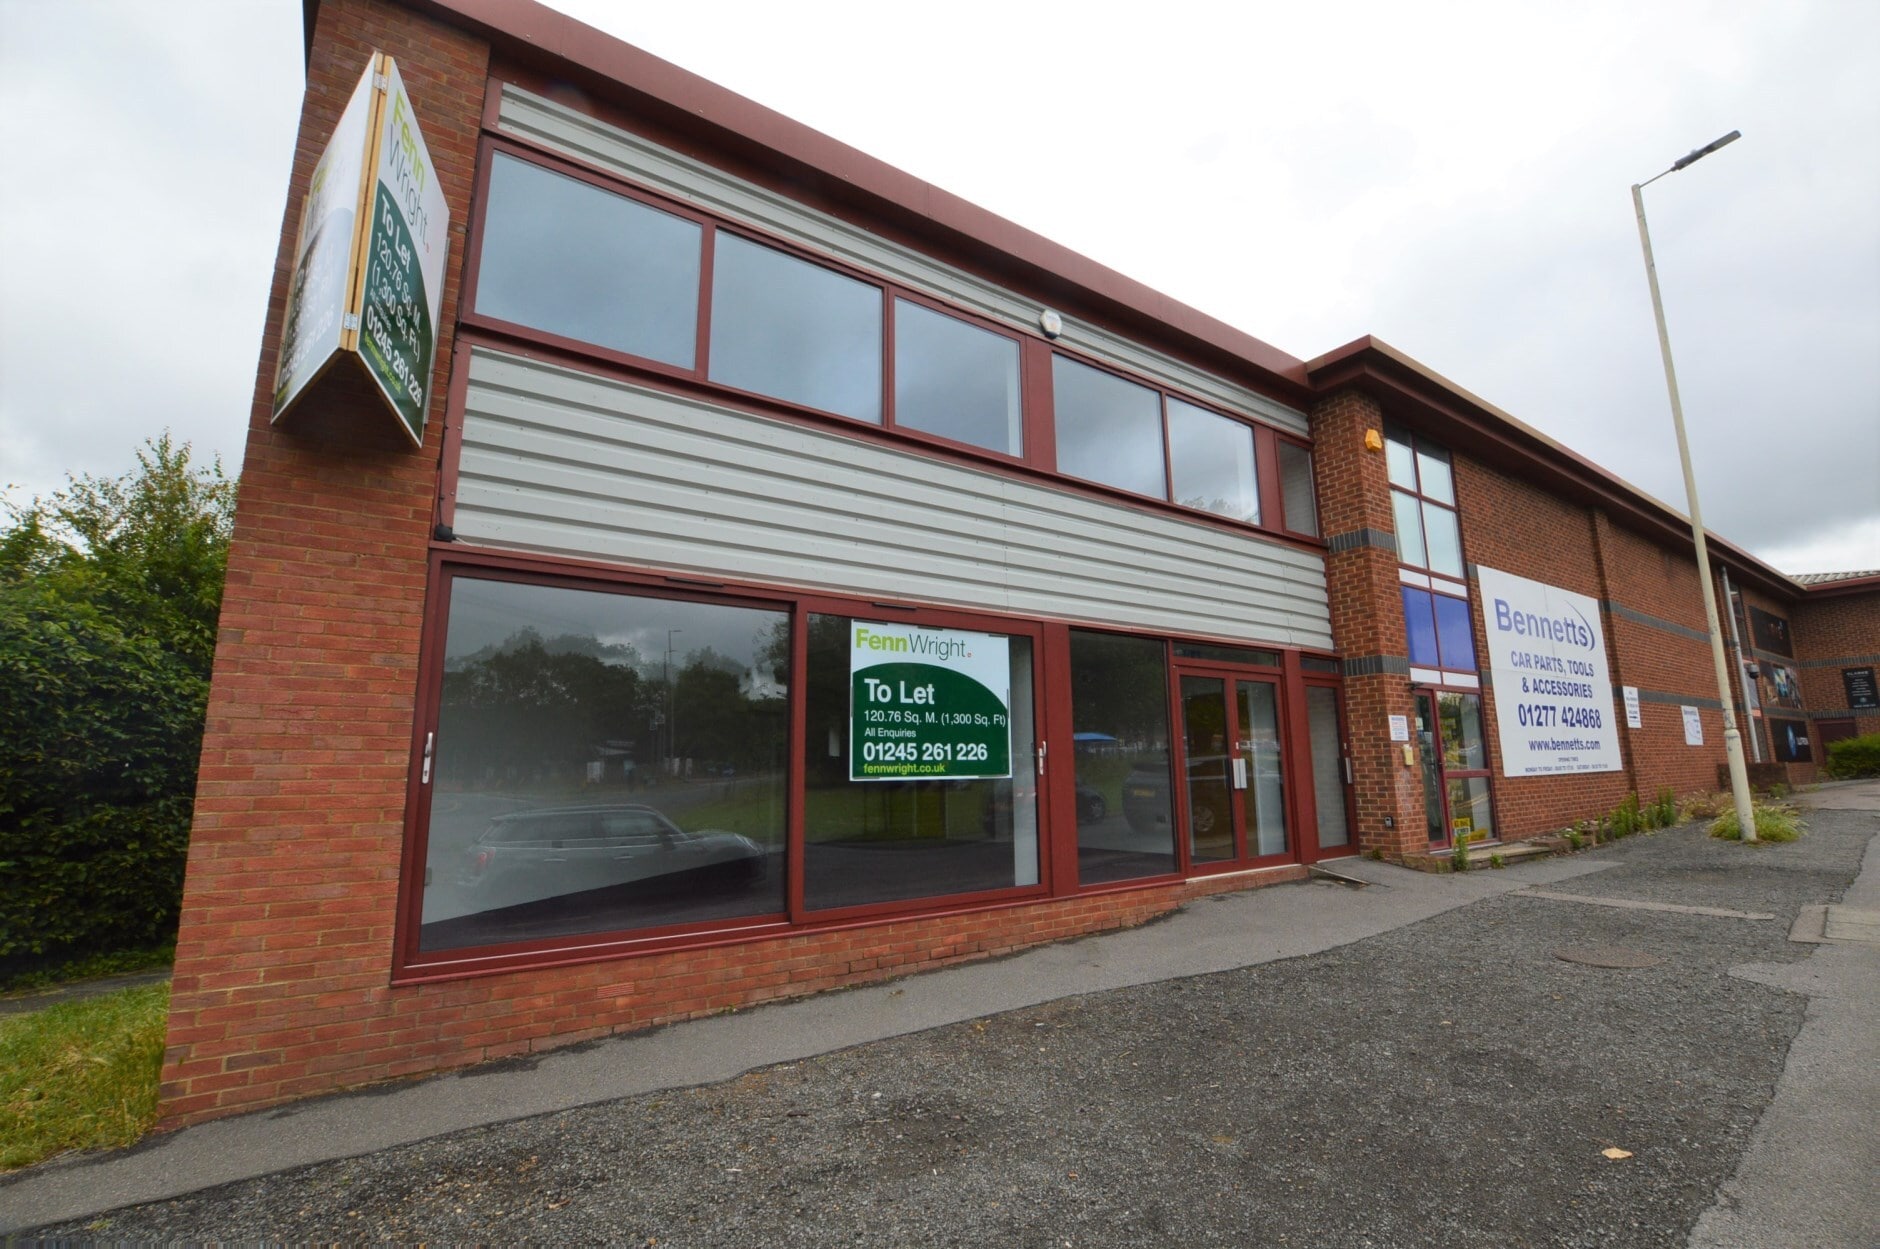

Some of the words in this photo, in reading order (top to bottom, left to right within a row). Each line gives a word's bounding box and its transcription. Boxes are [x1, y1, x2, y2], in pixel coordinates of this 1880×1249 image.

[394, 90, 424, 193] Fenn
[382, 193, 393, 236] To
[395, 225, 410, 273] Let
[377, 232, 402, 291] 120.76
[367, 305, 392, 361] 01245
[393, 350, 408, 386] 261
[408, 374, 422, 408] 226
[1494, 598, 1589, 648] Bennetts
[856, 628, 908, 652] Fenn
[1511, 650, 1532, 669] CAR
[1534, 654, 1567, 677] PARTS,
[1567, 659, 1594, 677] TOOLS
[864, 678, 892, 703] To
[900, 681, 935, 705] Let
[1522, 677, 1530, 693] &
[1533, 678, 1593, 699] ACCESSORIES
[864, 710, 901, 722] 120.76
[904, 711, 922, 726] Sq.
[925, 712, 938, 724] M.
[941, 713, 972, 726] (1,300
[974, 714, 990, 727] Sq.
[993, 714, 1006, 728] Ft)
[1518, 703, 1556, 727] 01277
[1561, 706, 1602, 729] 424868
[864, 728, 876, 737] All
[878, 728, 917, 740] Enquiries
[1528, 736, 1601, 751] www.bennetts.com
[863, 742, 918, 761] 01245
[922, 743, 952, 761] 261
[956, 743, 988, 761] 226
[863, 763, 946, 775] fennwright.co.uk
